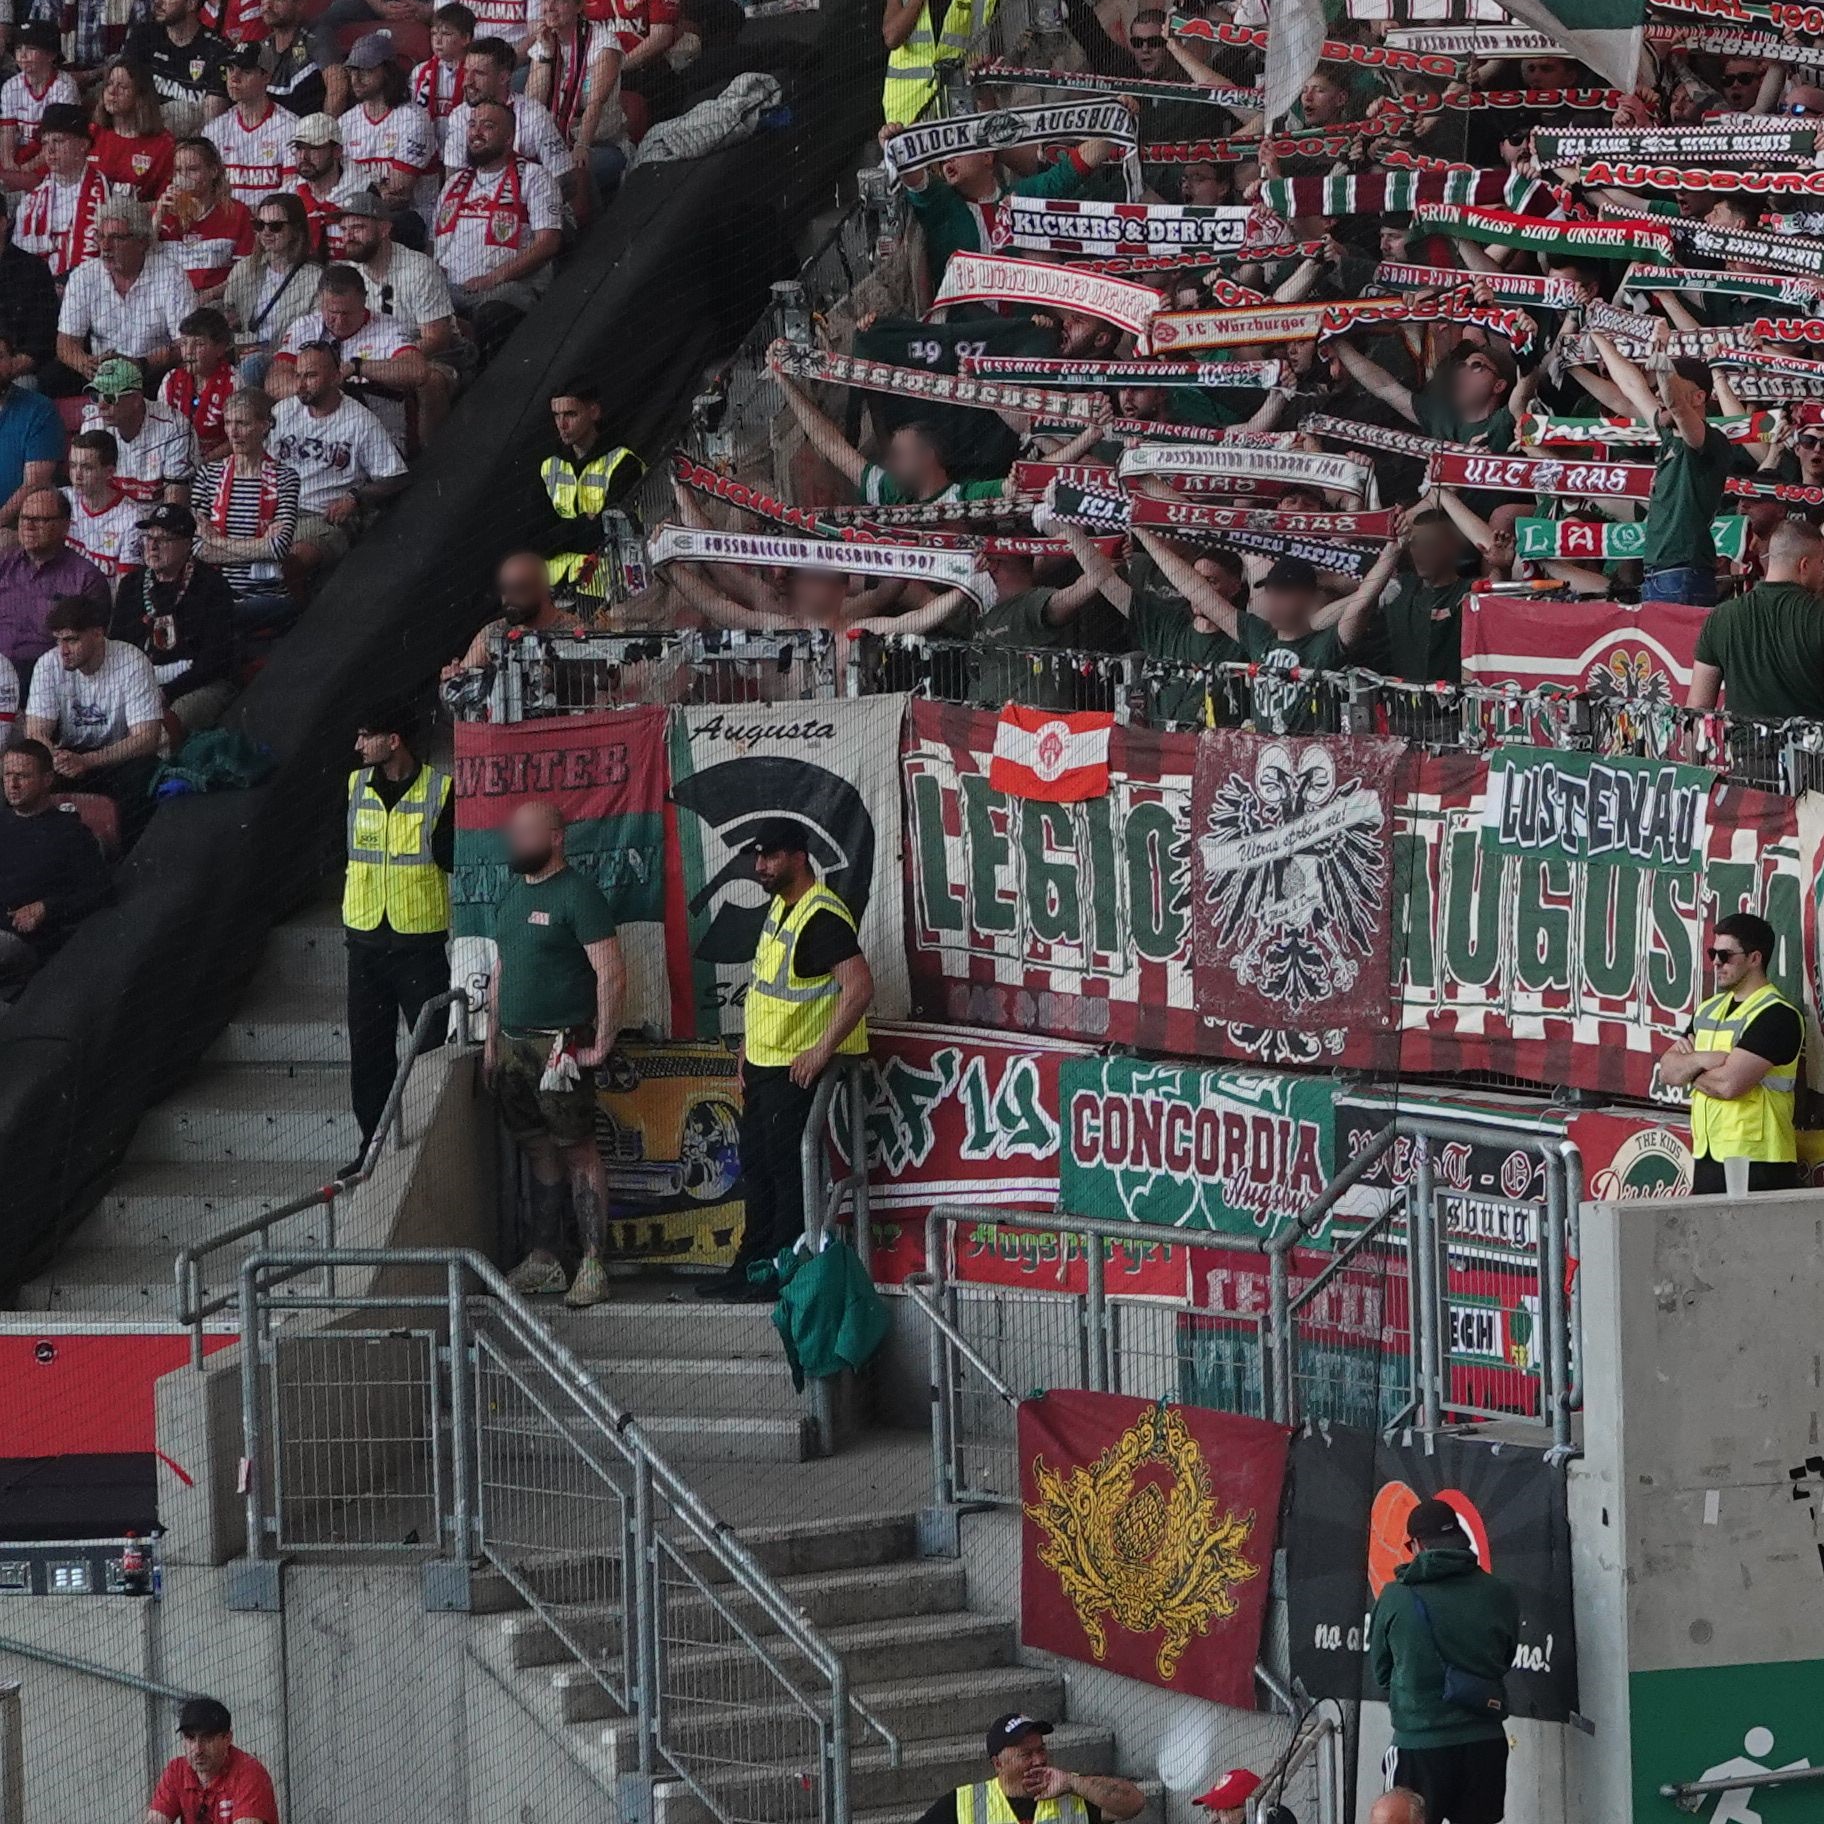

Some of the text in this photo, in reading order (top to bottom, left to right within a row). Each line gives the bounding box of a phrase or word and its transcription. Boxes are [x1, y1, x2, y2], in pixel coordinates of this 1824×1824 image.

[1013, 211, 1245, 244] KICKERS & DER FCA
[1467, 211, 1627, 247] WEISS SIND UNSERE
[1464, 460, 1628, 490] ULT RAS
[703, 537, 936, 571] FUSSBALLCLUB AUGSBURG 1907
[689, 713, 837, 749] Augusta
[1498, 758, 1701, 866] LUSTENAU
[913, 773, 1191, 957] LEGIO
[1070, 1087, 1324, 1192] CONCORDIA
[1635, 1133, 1684, 1159] THE KIDS
